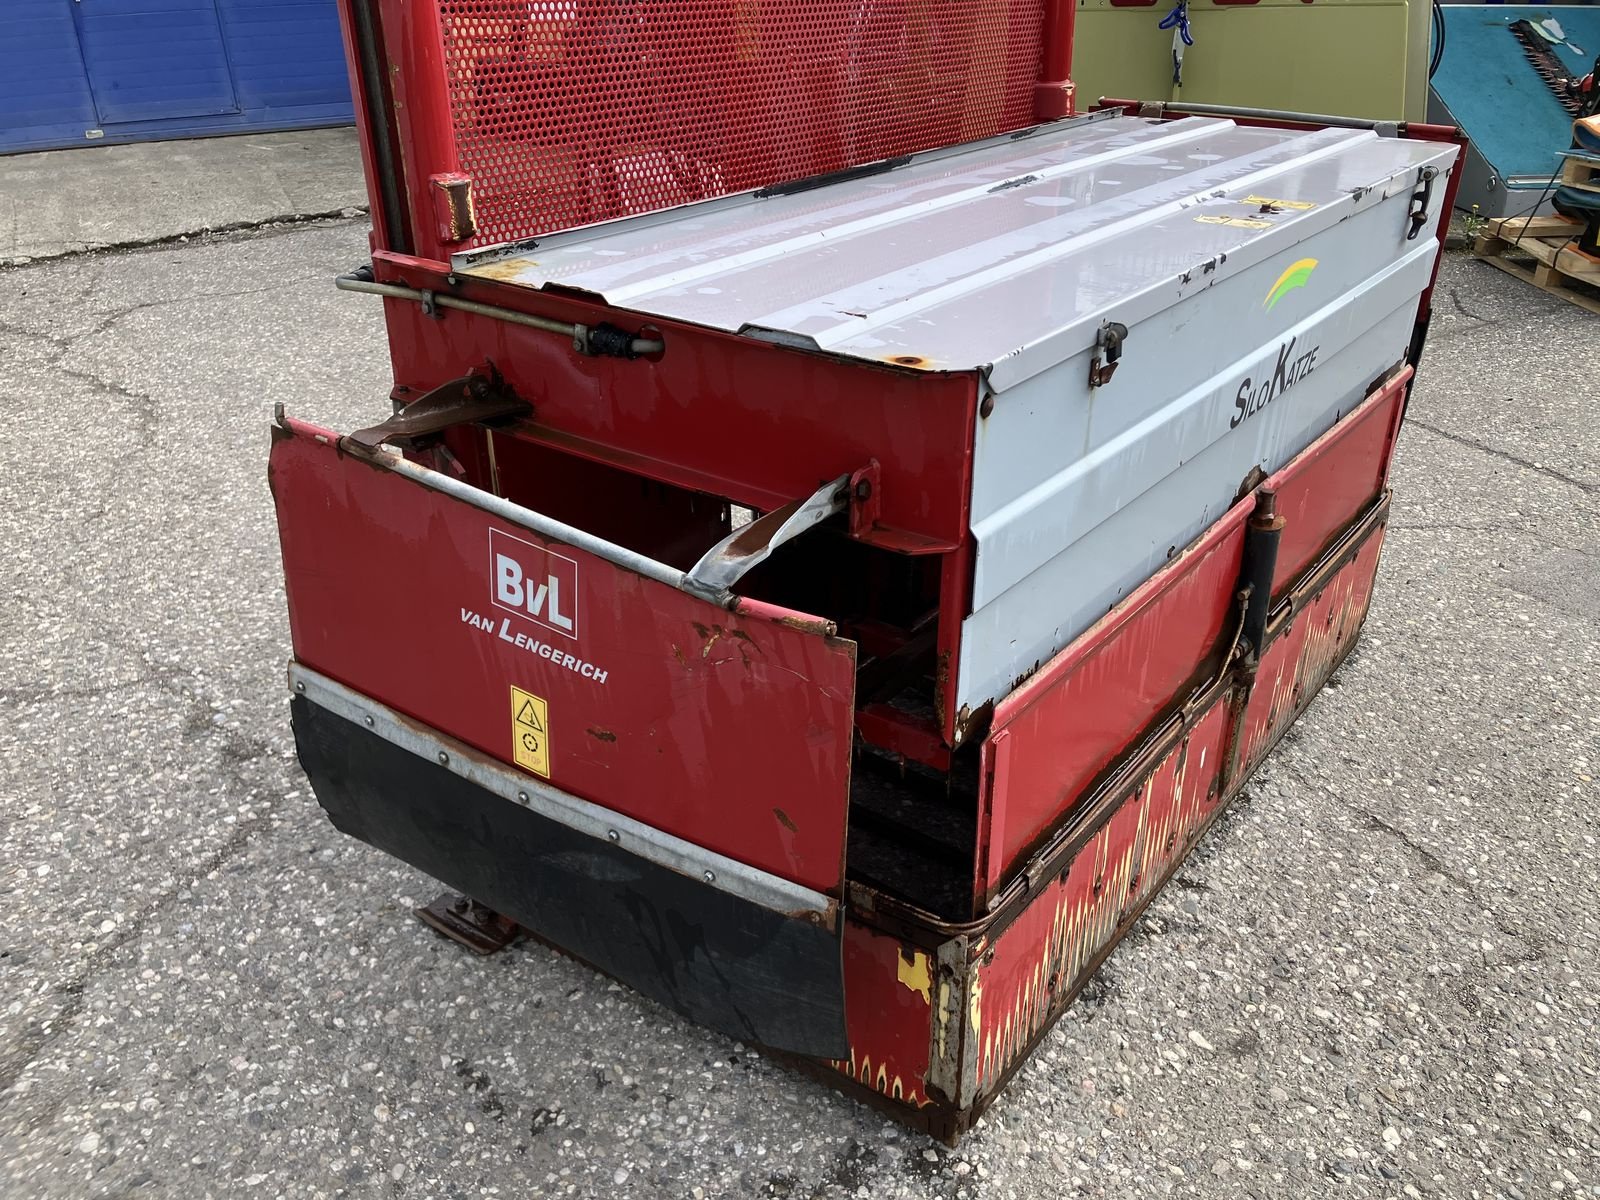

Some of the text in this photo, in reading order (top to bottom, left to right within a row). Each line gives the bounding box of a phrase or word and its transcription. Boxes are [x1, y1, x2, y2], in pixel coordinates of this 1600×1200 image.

[496, 553, 572, 631] BvL
[460, 607, 609, 684] VAN LENGERICH
[520, 751, 542, 766] STOP
